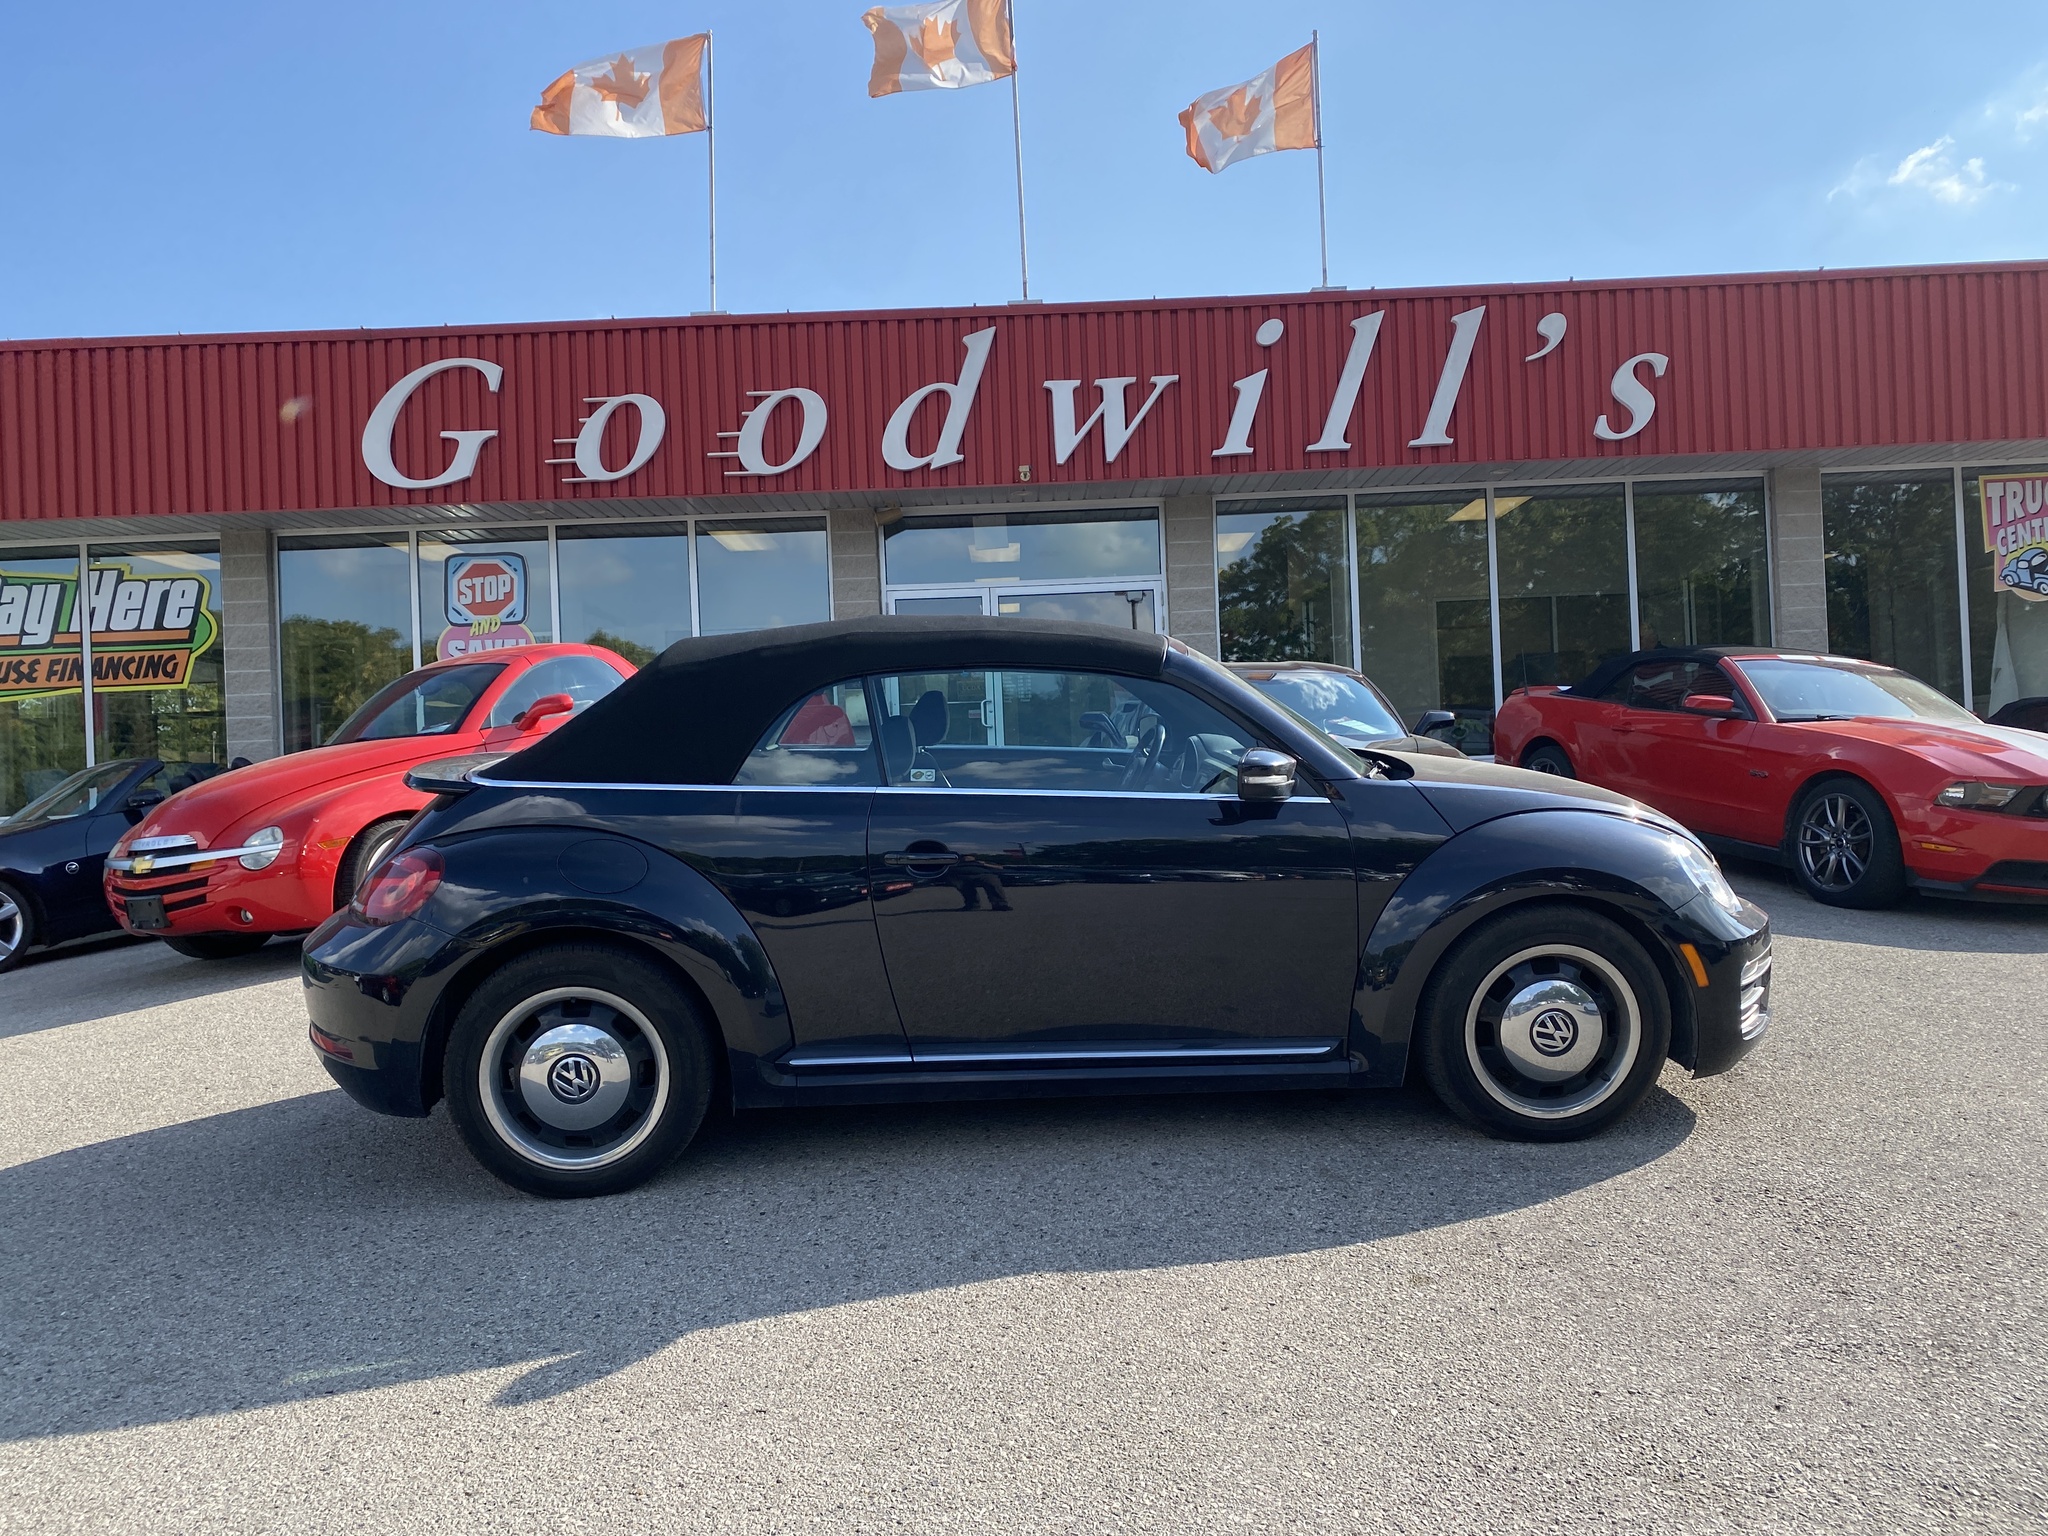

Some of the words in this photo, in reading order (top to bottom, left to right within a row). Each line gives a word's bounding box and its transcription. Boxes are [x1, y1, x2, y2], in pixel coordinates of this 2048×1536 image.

[361, 305, 1669, 490] Goodwill's
[1986, 480, 2048, 527] TRU
[0, 582, 61, 646] ay
[69, 570, 199, 633] Here
[459, 573, 511, 605] STOP
[470, 617, 501, 637] AND
[45, 654, 179, 683] FINANCING
